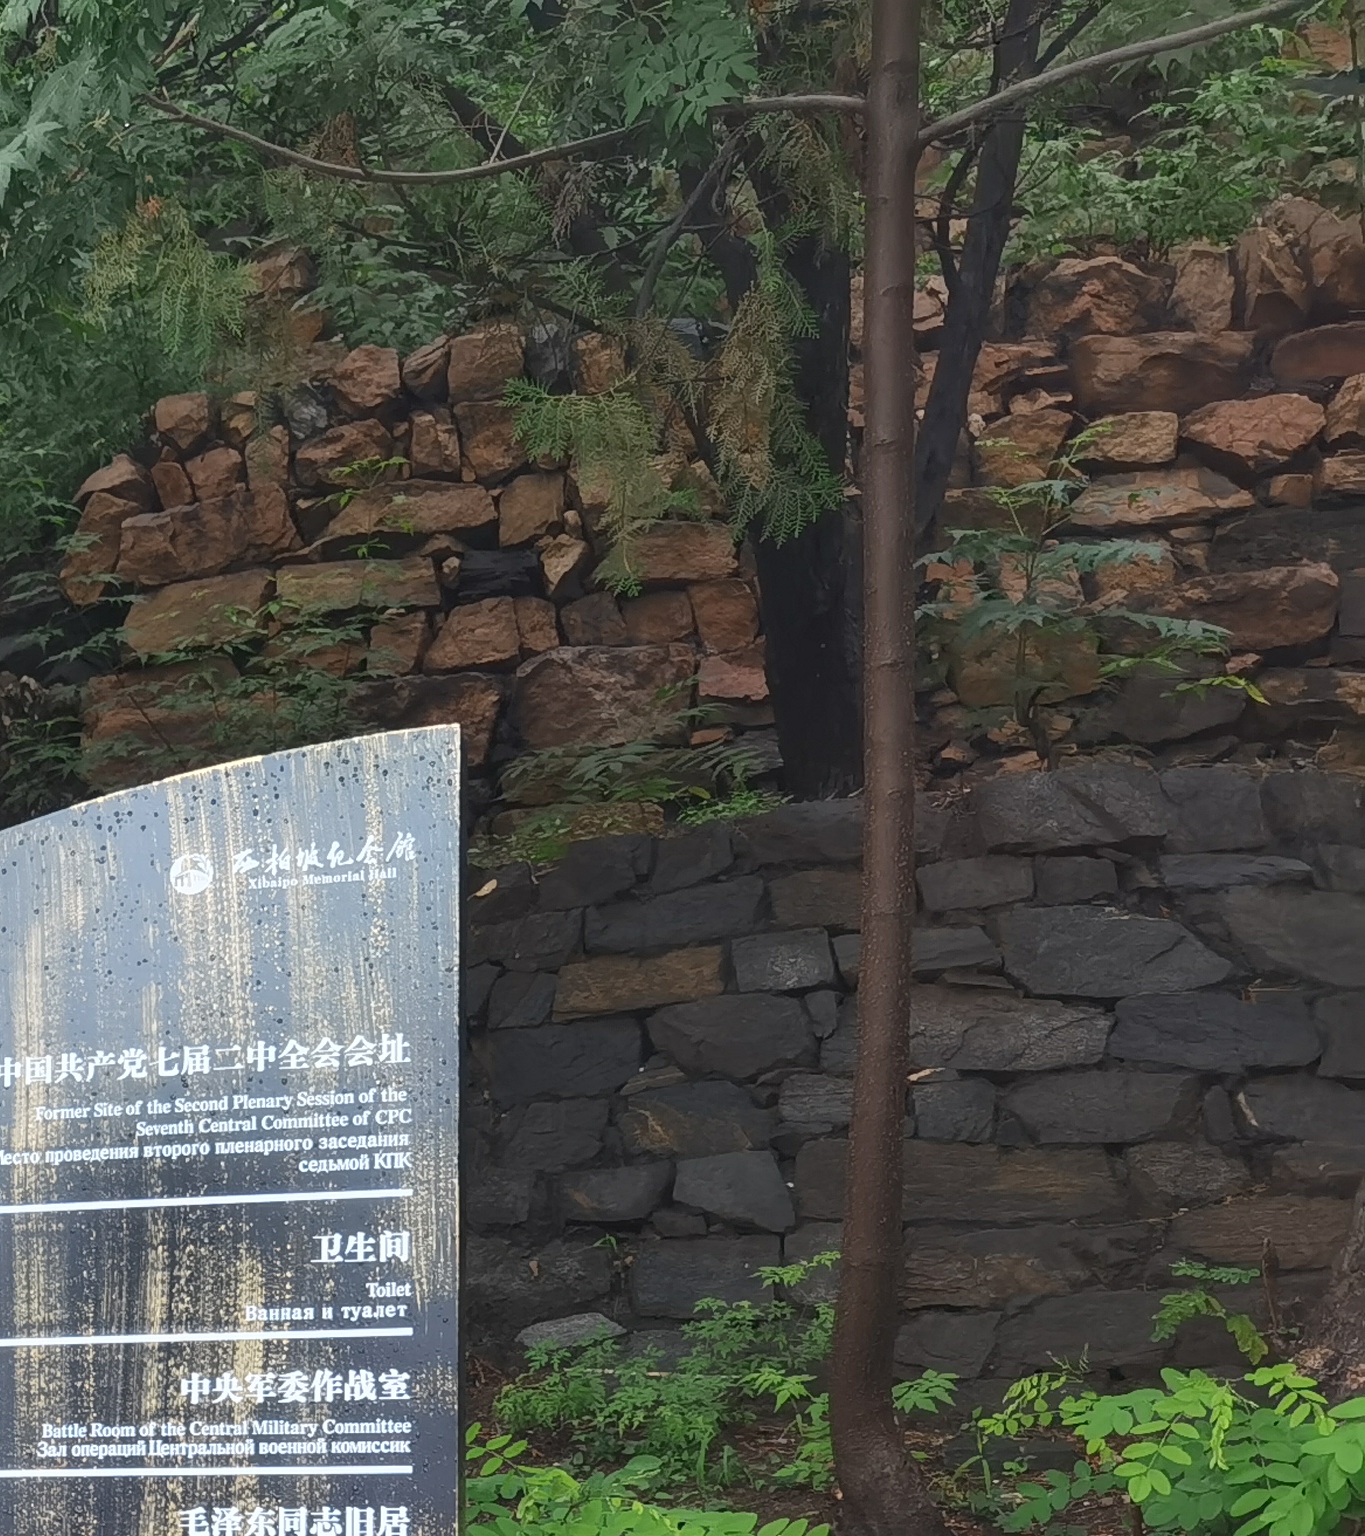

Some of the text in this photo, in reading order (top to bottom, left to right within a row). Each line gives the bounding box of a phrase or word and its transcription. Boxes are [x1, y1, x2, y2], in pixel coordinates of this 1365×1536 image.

[248, 867, 397, 891] Xibaipo Memorial Hall
[36, 1088, 408, 1121] Former Site of the Second Plenary Session of the
[136, 1108, 412, 1138] Seventh Central Committee of CPC
[45, 1145, 139, 1165] проведения
[143, 1142, 210, 1160] второго
[214, 1137, 313, 1156] пленарного
[318, 1133, 409, 1152] заседания
[298, 1152, 412, 1174] седьмой КПК
[311, 1231, 410, 1264] 卫生间
[366, 1282, 411, 1298] Toilet
[245, 1303, 407, 1322] Ванная и туалет
[180, 1368, 411, 1404] 中央军委作战室
[42, 1418, 412, 1439] Battle Room of the Central Military Committee
[37, 1441, 67, 1457] Зал
[71, 1439, 146, 1459] операций
[149, 1439, 255, 1458] Центральной
[258, 1438, 327, 1455] военной
